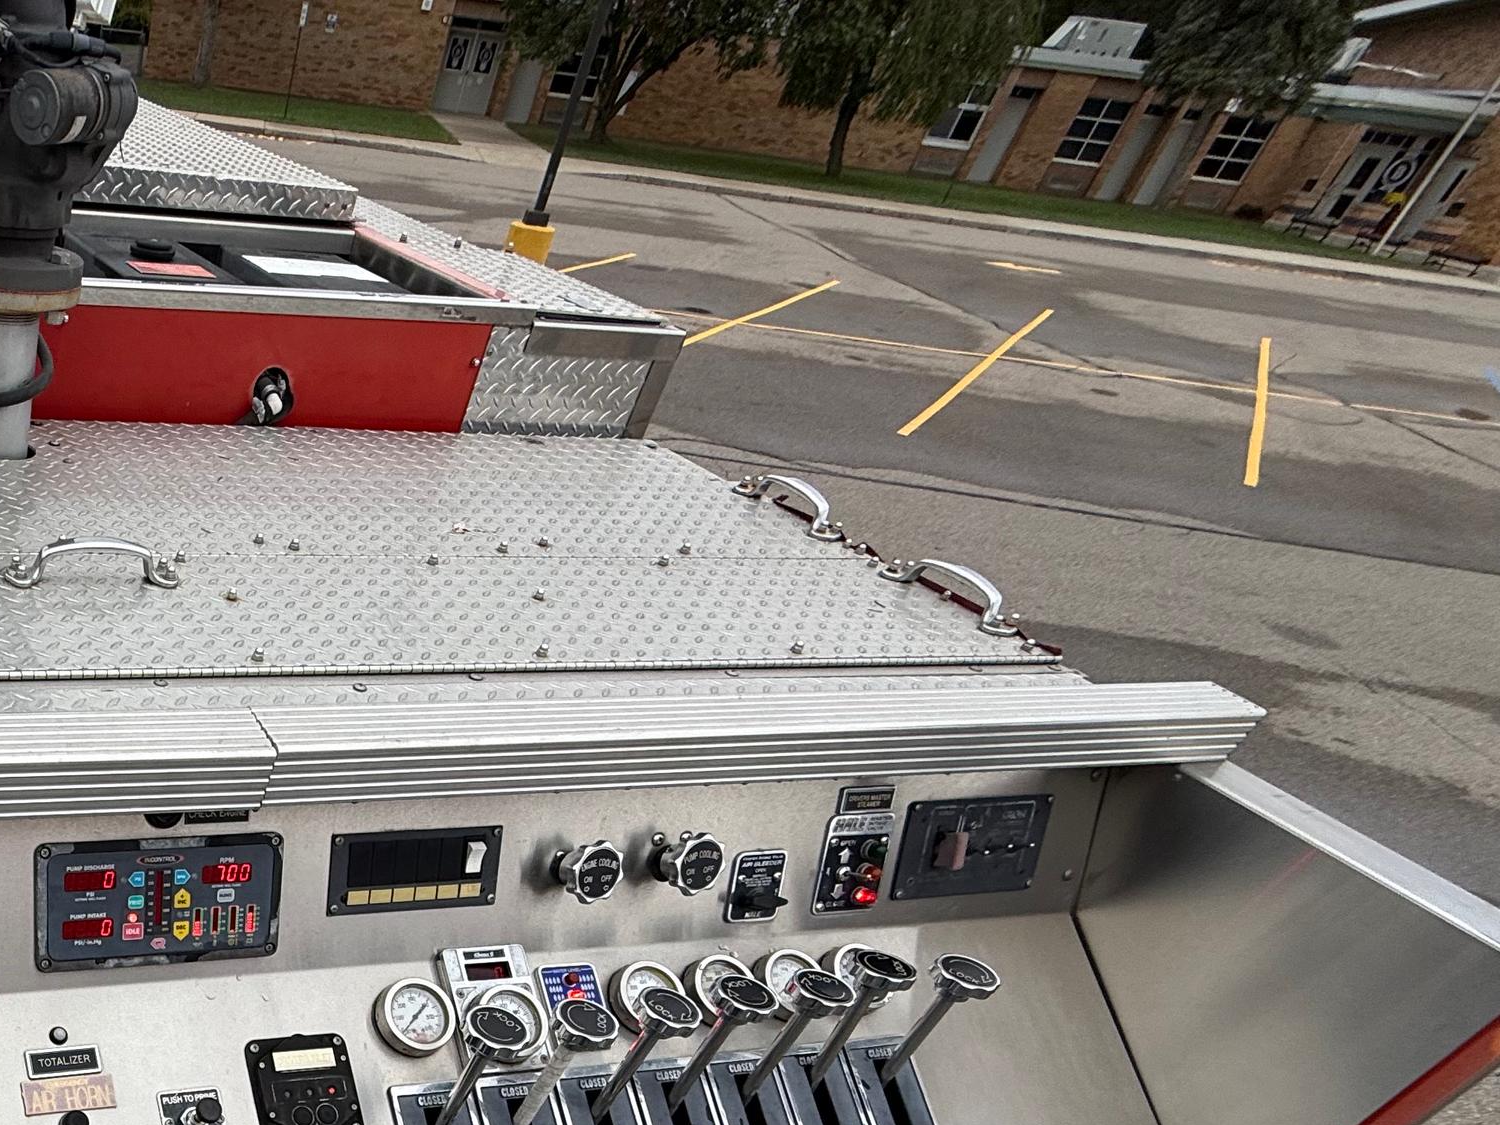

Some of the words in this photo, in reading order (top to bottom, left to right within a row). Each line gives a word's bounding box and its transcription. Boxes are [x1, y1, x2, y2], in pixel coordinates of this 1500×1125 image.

[683, 851, 699, 864] PUMP
[700, 850, 721, 860] COOLING
[598, 858, 618, 870] COOLING
[218, 864, 250, 882] 700
[686, 868, 696, 876] ON
[702, 865, 715, 873] OFF
[104, 871, 114, 888] 0
[584, 876, 593, 884] ON
[601, 874, 613, 882] OFF
[101, 920, 112, 936] 0
[808, 973, 839, 985] LOCK
[949, 968, 980, 984] LOCK
[725, 979, 753, 988] LOCK
[648, 1000, 677, 1021] LOCK
[492, 1011, 522, 1032] LOCK
[597, 1012, 606, 1034] LOCK
[38, 1054, 92, 1067] TOTALIZER
[728, 1063, 754, 1073] CLOSED
[656, 1070, 682, 1080] CLOSED
[579, 1078, 607, 1089] CLOSED
[500, 1086, 528, 1097] CLOSED
[32, 1090, 57, 1112] AIR
[64, 1084, 112, 1109] HORN
[162, 1096, 182, 1105] PUSH
[184, 1094, 194, 1103] TO
[418, 1095, 446, 1106] CLOSED
